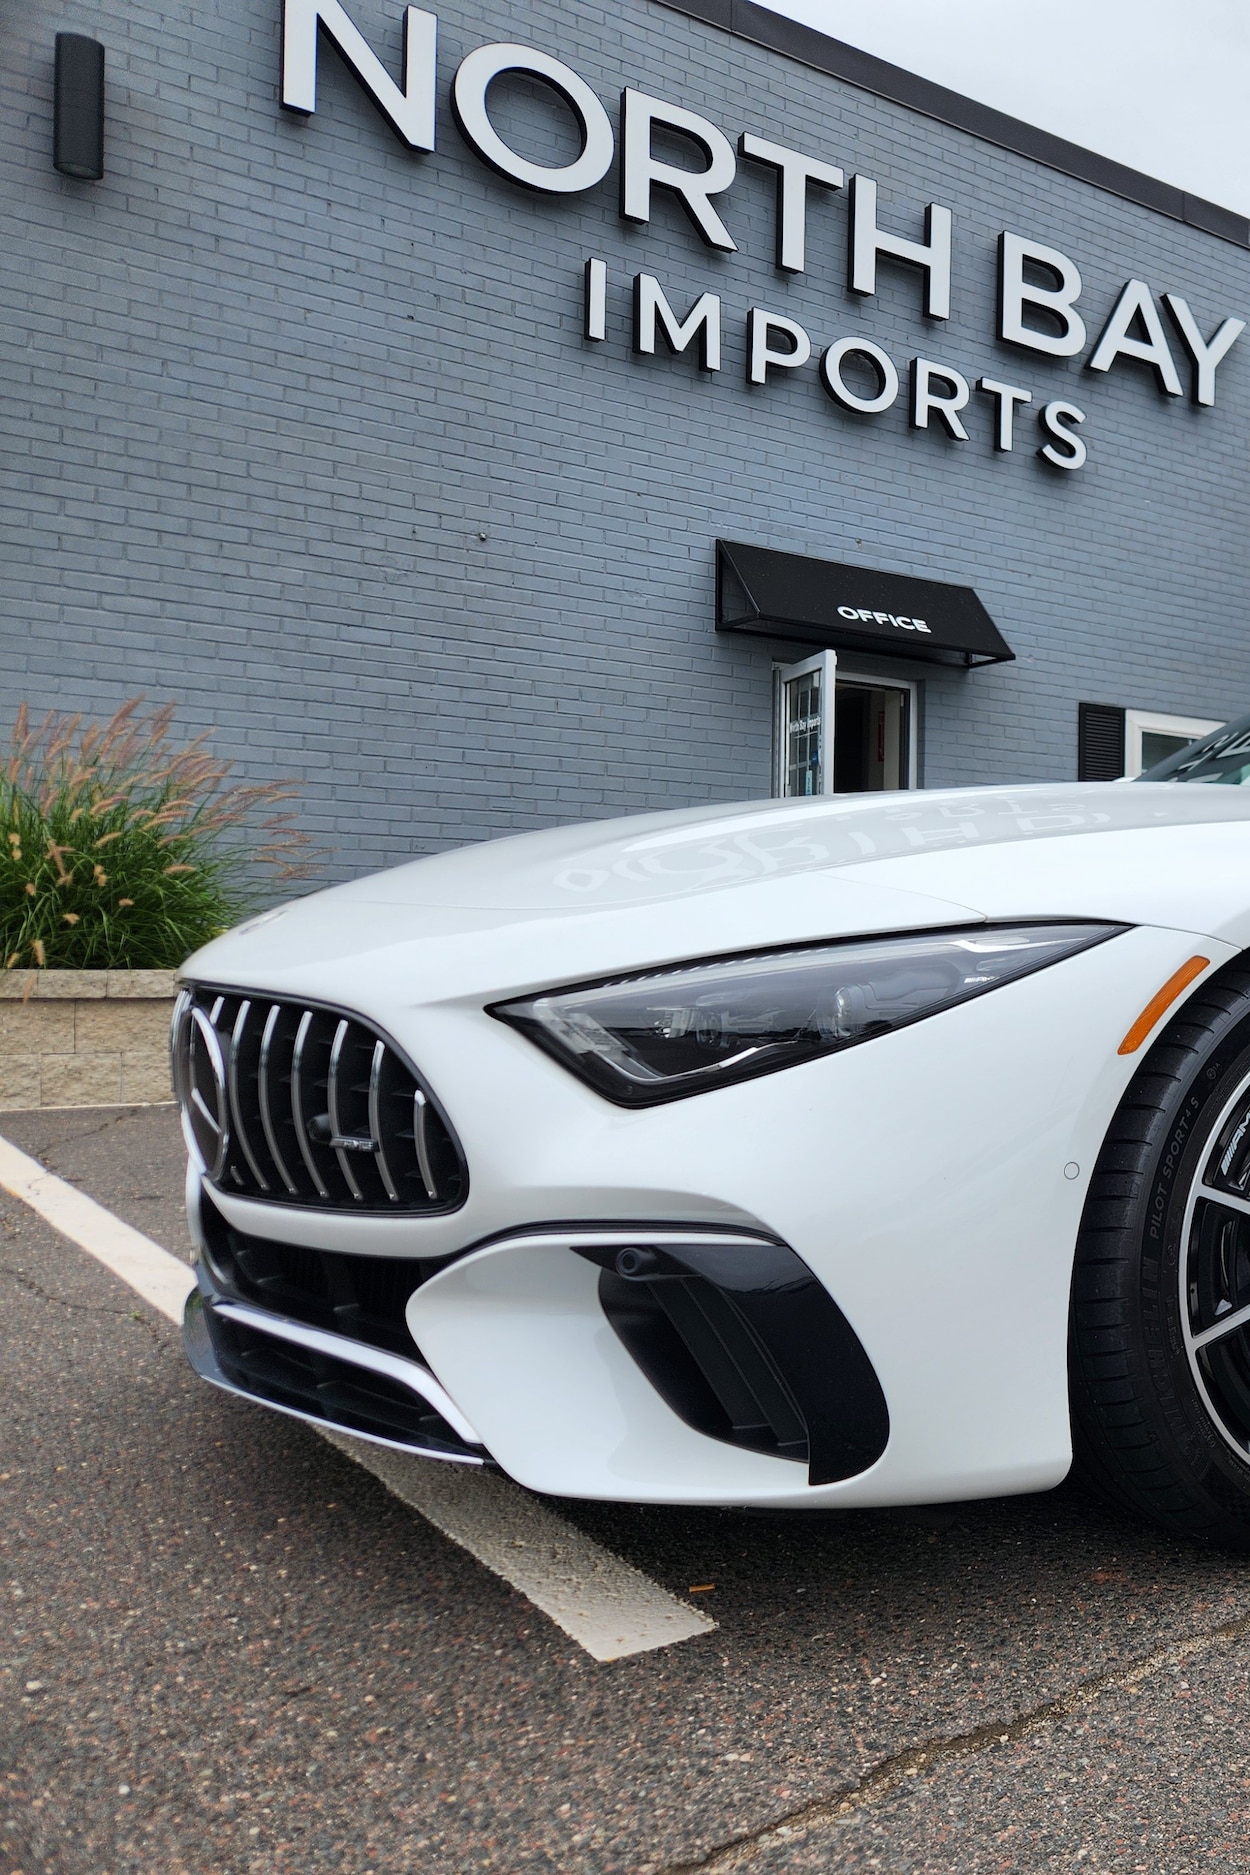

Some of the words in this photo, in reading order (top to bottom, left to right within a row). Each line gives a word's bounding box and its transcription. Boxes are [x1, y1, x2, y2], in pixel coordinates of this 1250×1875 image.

[280, 0, 953, 322] NORTH
[997, 230, 1247, 407] BAY
[584, 258, 1088, 471] IMPORTS
[836, 605, 932, 634] OFFICE
[1149, 1182, 1169, 1240] PILOT
[1162, 1114, 1189, 1179] SPORT
[1143, 1256, 1186, 1433] MICHELIN
